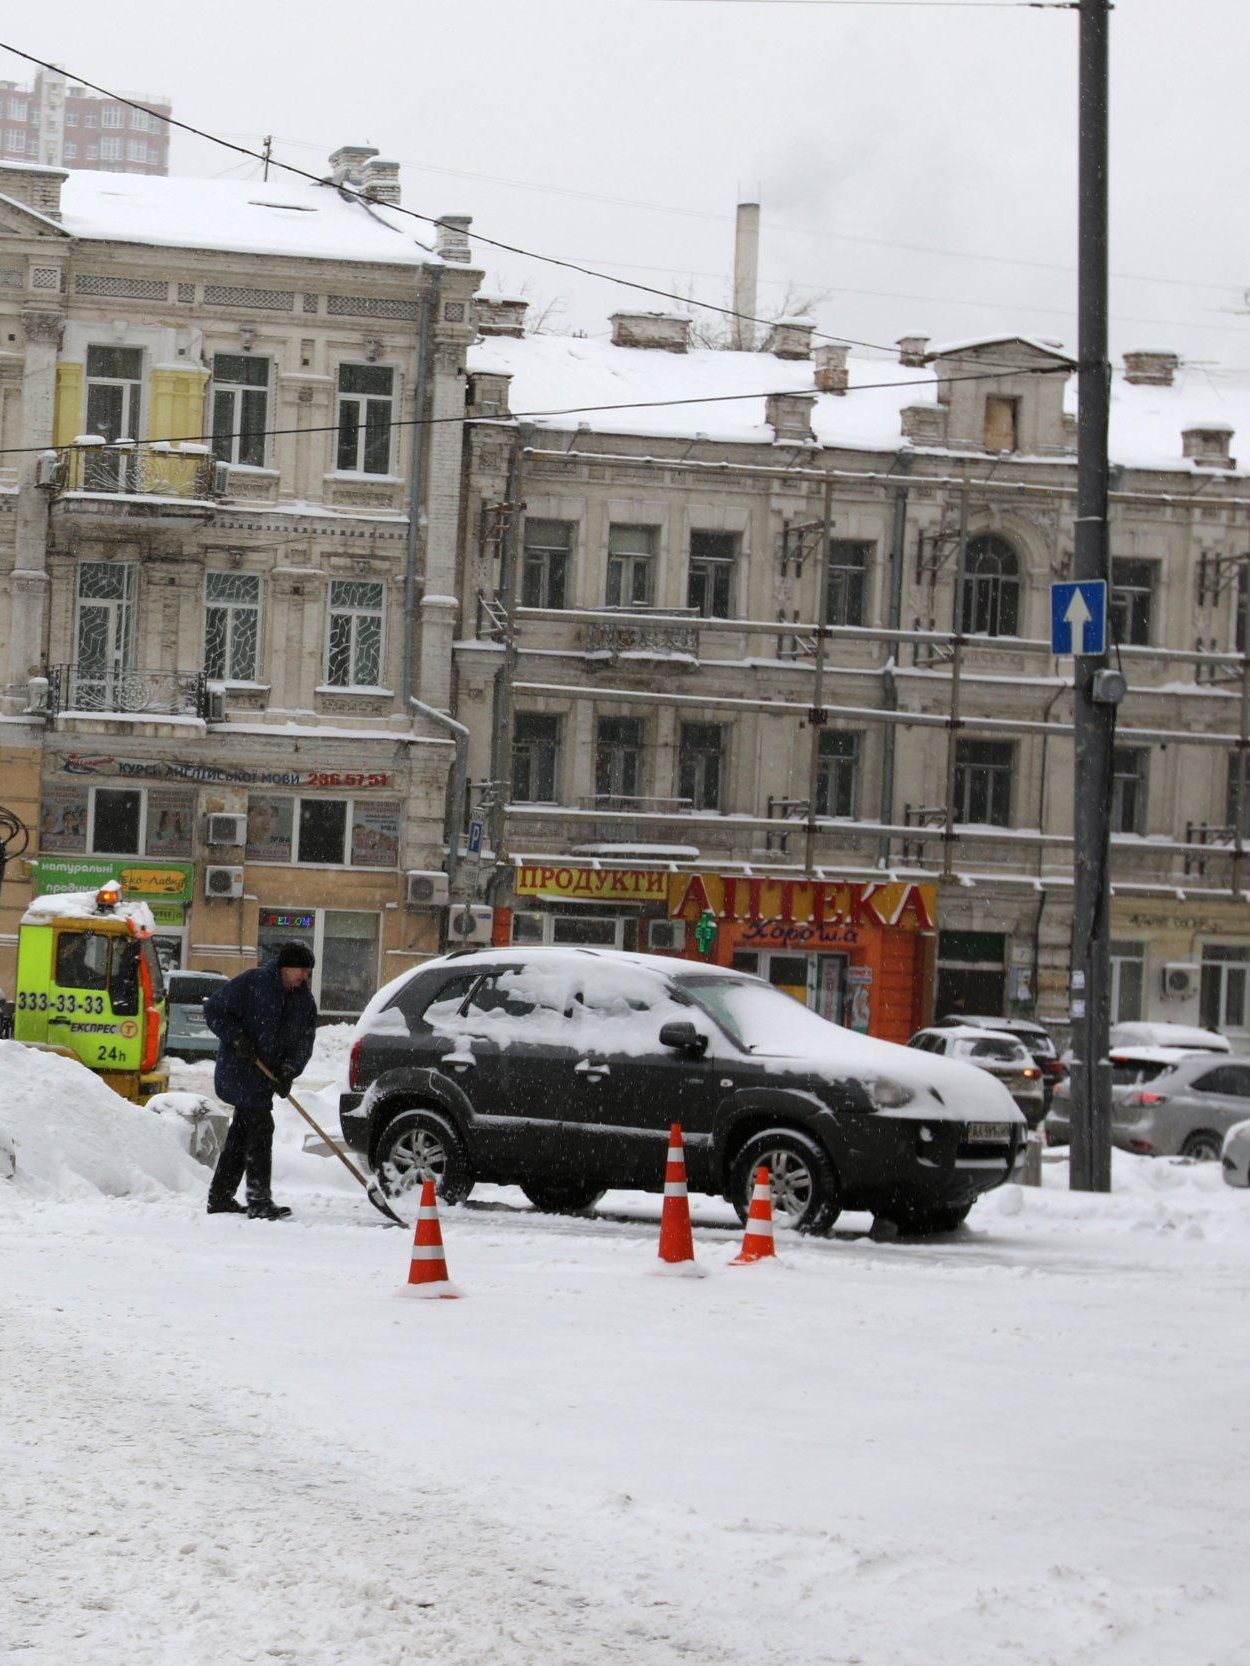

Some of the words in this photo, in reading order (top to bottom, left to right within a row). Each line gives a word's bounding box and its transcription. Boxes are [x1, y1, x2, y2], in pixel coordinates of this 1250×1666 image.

[261, 772, 300, 784] МОВИ
[42, 863, 113, 875] натуральні
[519, 867, 664, 893] ПРОДУКТИ
[671, 873, 936, 928] АПТЕКА
[743, 920, 858, 947] Хороша
[18, 992, 104, 1014] 333-33-33
[71, 1022, 117, 1034] ЕКСПРЕС
[98, 1046, 126, 1061] 24h
